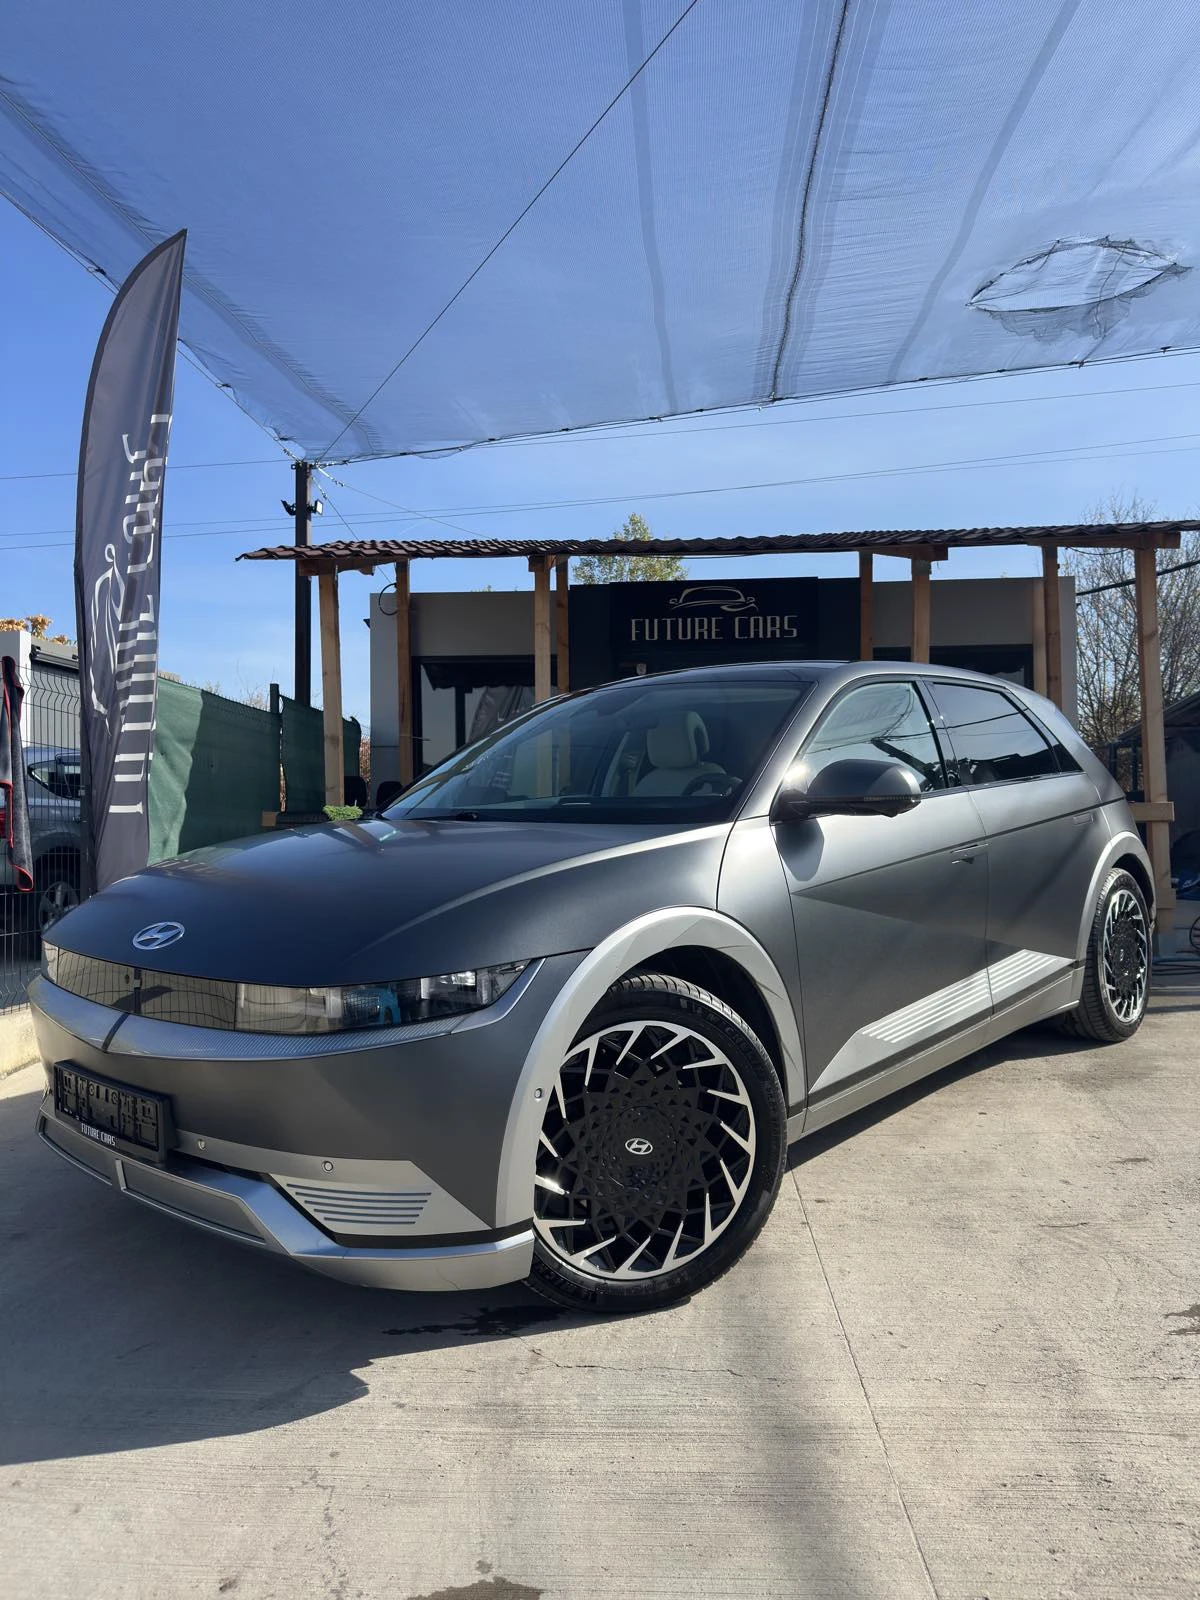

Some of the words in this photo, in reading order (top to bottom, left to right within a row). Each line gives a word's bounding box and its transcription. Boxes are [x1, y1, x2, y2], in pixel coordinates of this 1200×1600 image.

[631, 616, 724, 642] FUTURE
[734, 614, 798, 640] CARS
[81, 1122, 100, 1140] FUTURE
[100, 1131, 116, 1146] CARS
